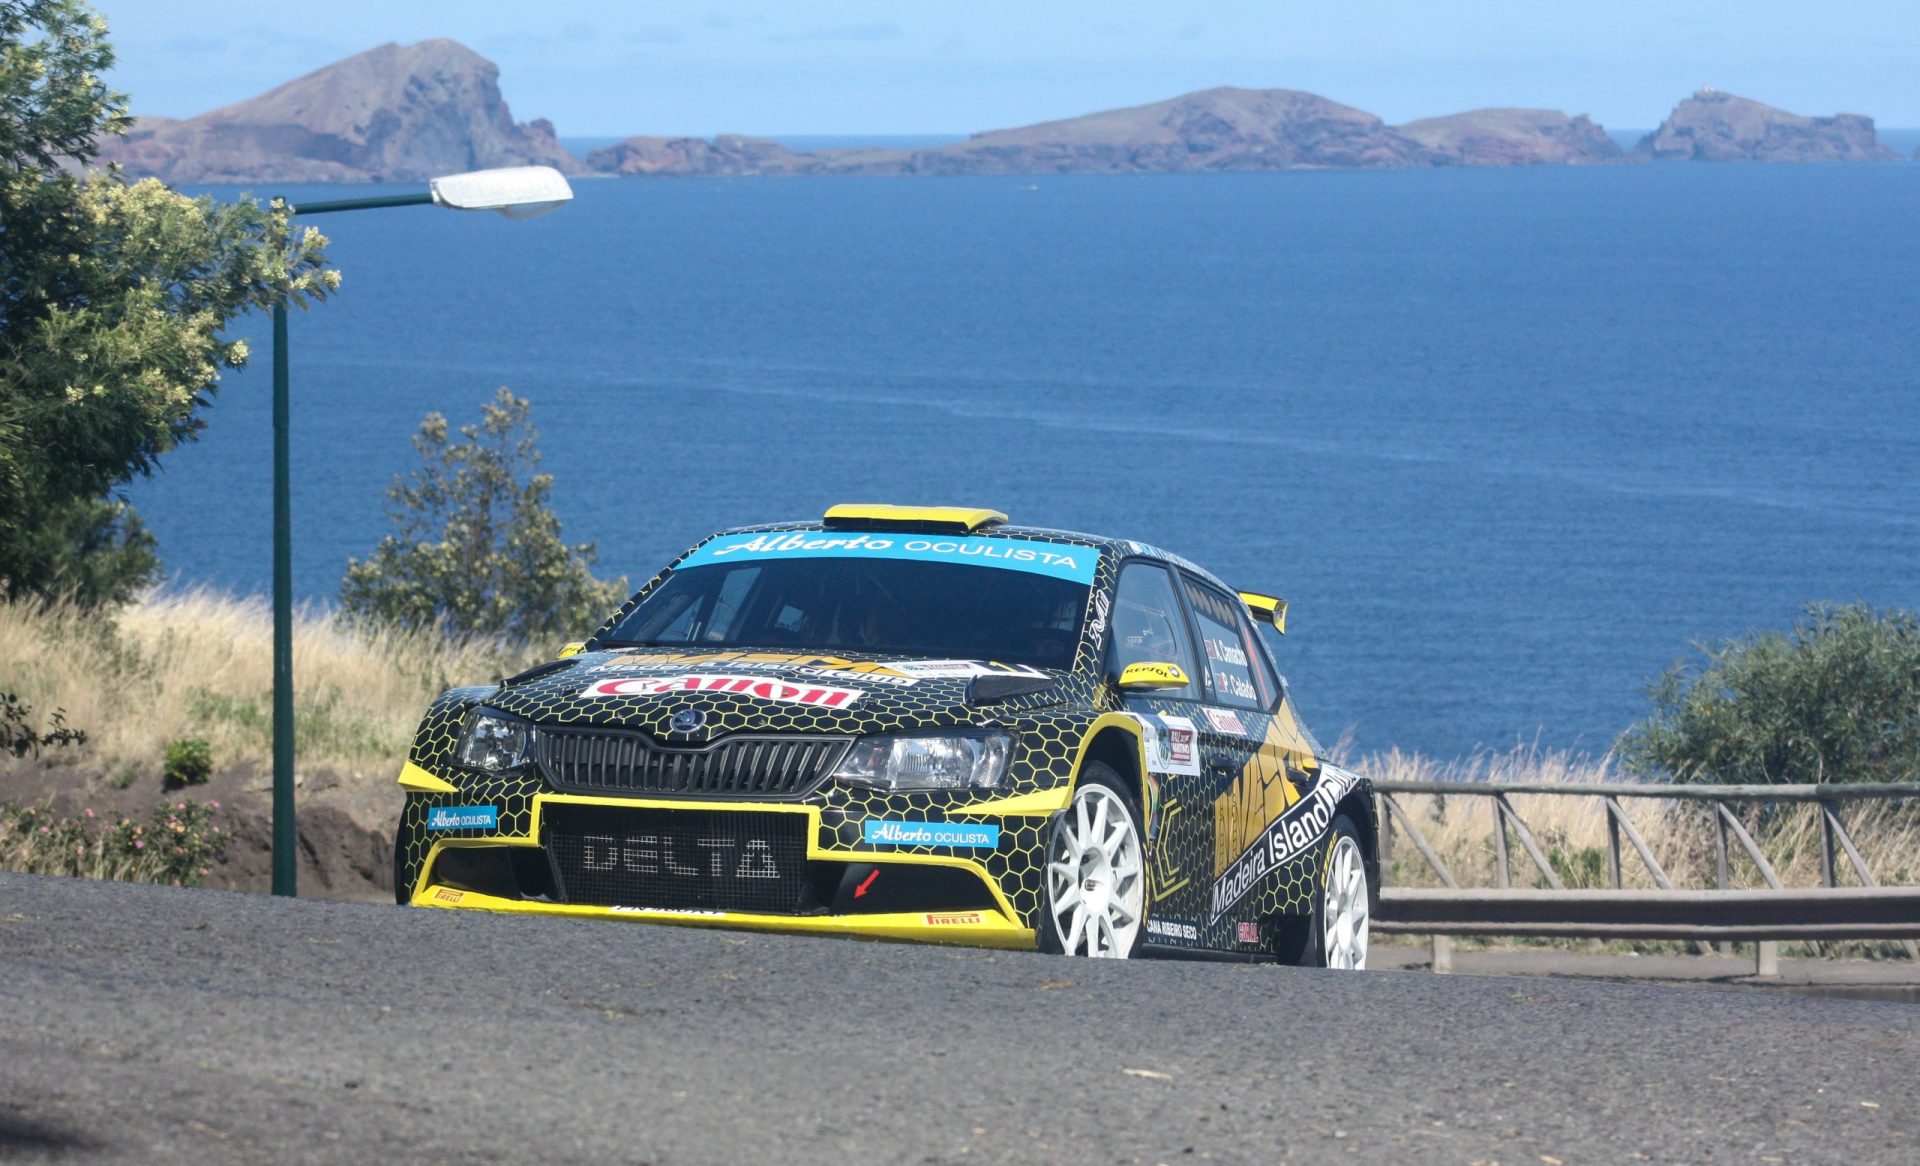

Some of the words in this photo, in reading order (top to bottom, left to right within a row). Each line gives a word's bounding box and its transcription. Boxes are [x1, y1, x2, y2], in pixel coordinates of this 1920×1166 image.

[713, 534, 895, 556] Alberto
[904, 540, 1078, 569] OCULISTA
[831, 670, 909, 685] Club
[597, 677, 851, 708] Canon
[431, 810, 460, 827] Alberto
[460, 815, 492, 826] OCULISTA
[871, 823, 932, 842] Alberto
[934, 832, 990, 844] OCULISTA
[583, 834, 781, 879] DELTA
[1212, 848, 1266, 919] Madeira
[1268, 792, 1329, 865] Island
[926, 913, 981, 925] PIRELLI
